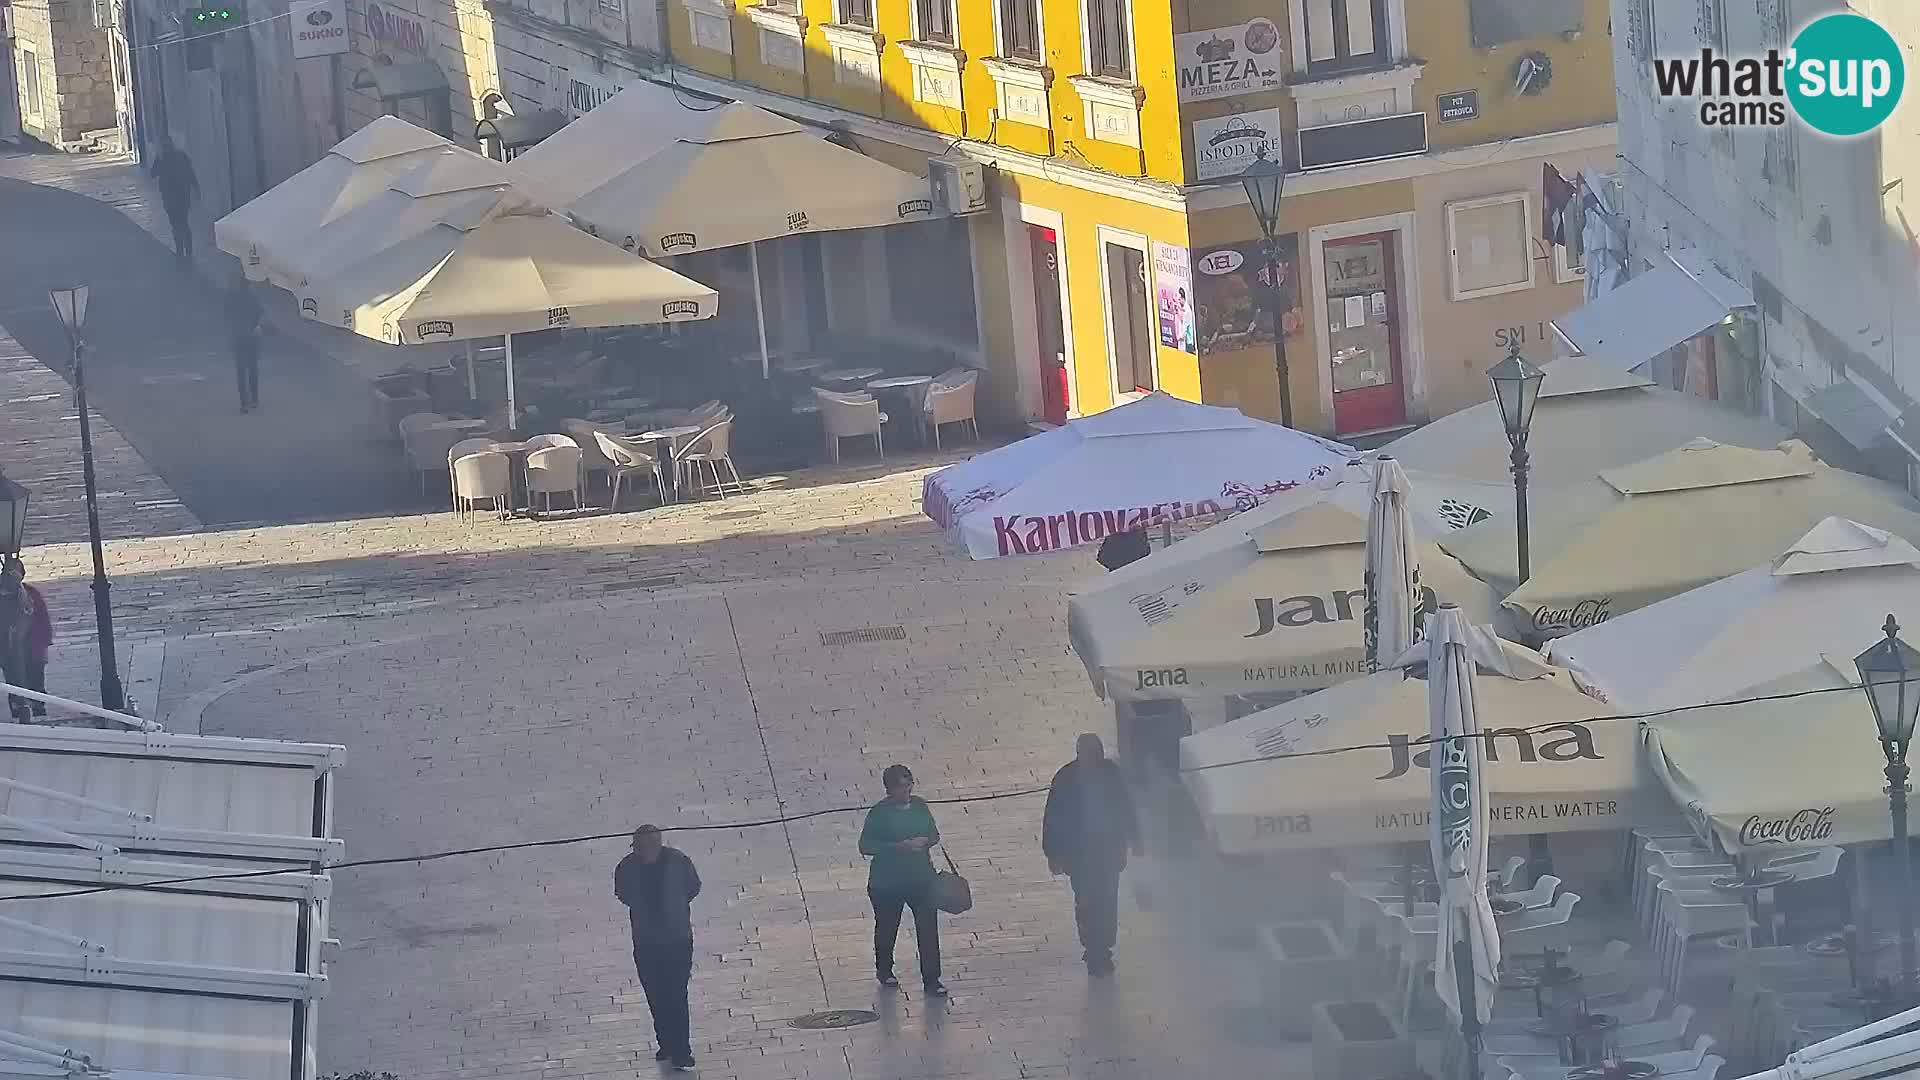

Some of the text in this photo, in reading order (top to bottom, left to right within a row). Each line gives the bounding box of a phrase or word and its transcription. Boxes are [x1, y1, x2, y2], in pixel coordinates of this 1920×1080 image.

[299, 27, 343, 41] SUKNO
[1181, 58, 1260, 89] MEZA
[1200, 144, 1245, 162] ISPOD
[1244, 659, 1366, 682] NATURAL MINE
[1489, 804, 1548, 822] NERAL
[1553, 800, 1618, 819] WATER
